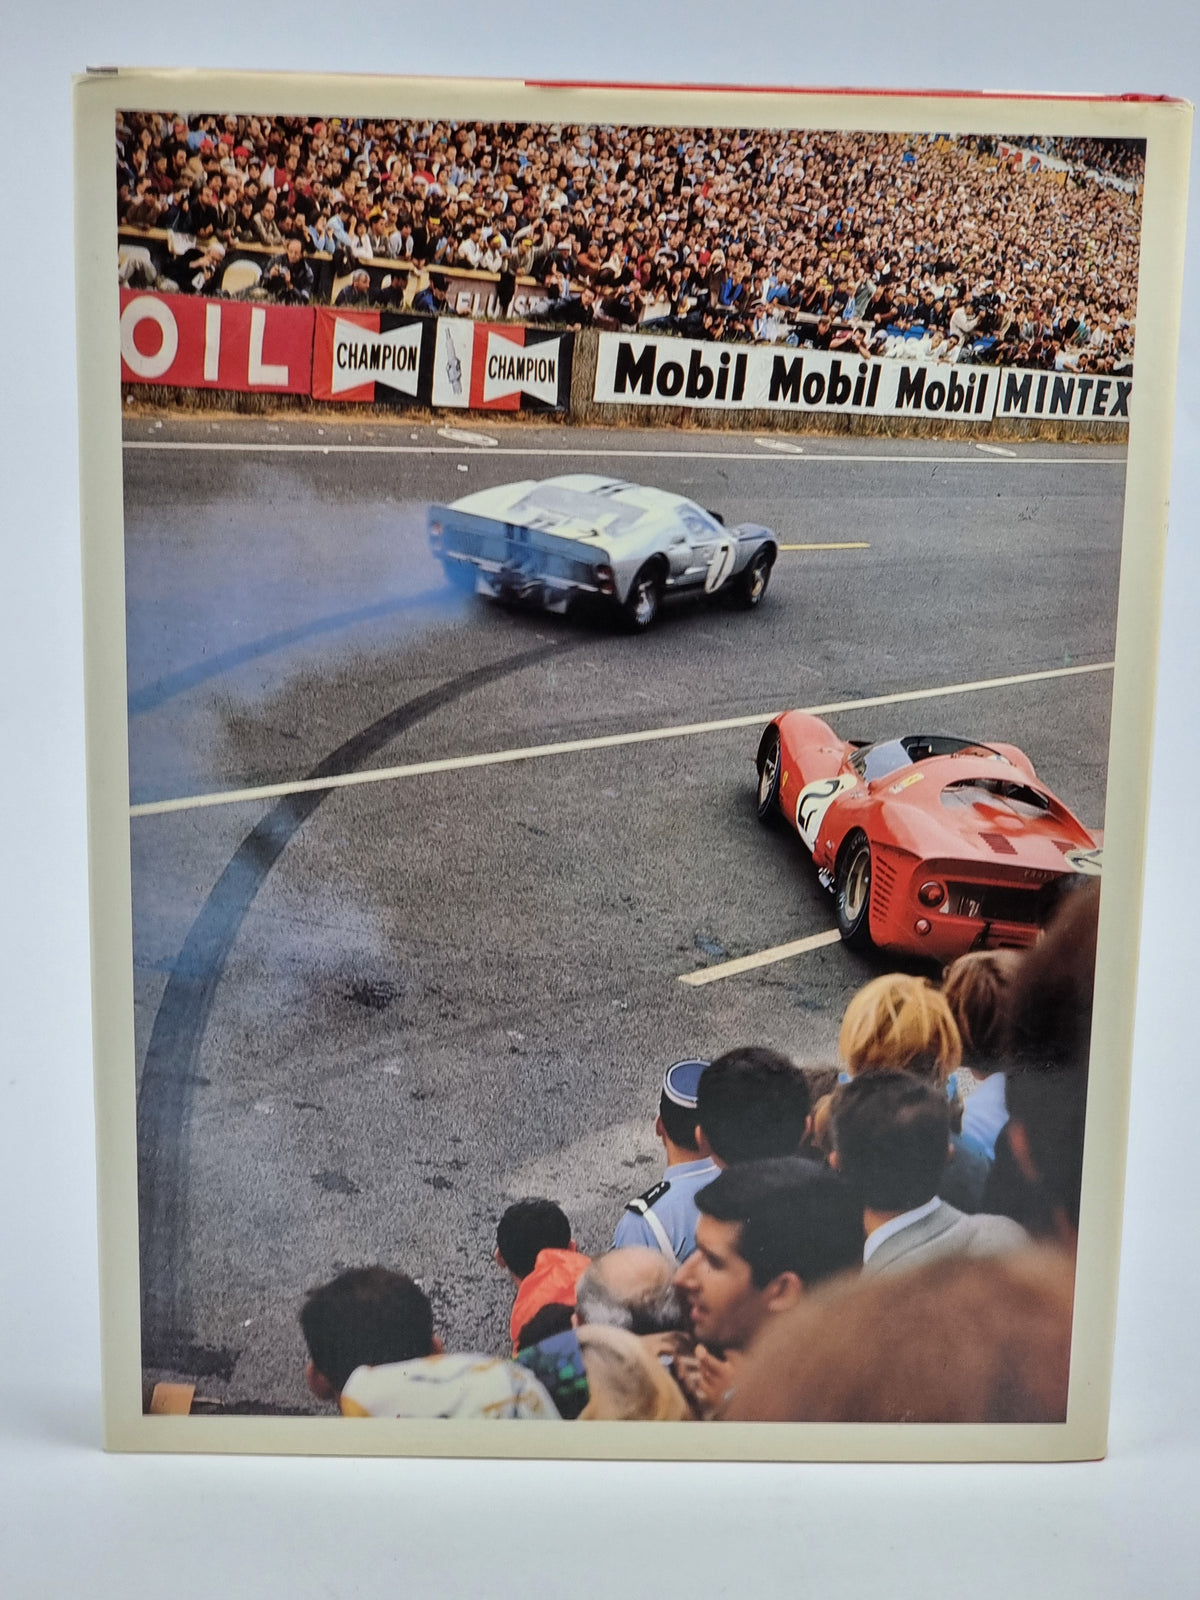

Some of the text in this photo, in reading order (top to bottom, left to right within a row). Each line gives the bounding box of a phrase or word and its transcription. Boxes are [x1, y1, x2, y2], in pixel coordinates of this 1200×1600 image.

[120, 295, 289, 387] OIL
[336, 342, 419, 372] CHAMPION
[488, 355, 556, 384] CHAMPION
[613, 341, 990, 414] Mobil Mobil Mobil
[1002, 373, 1133, 417] MINTEX
